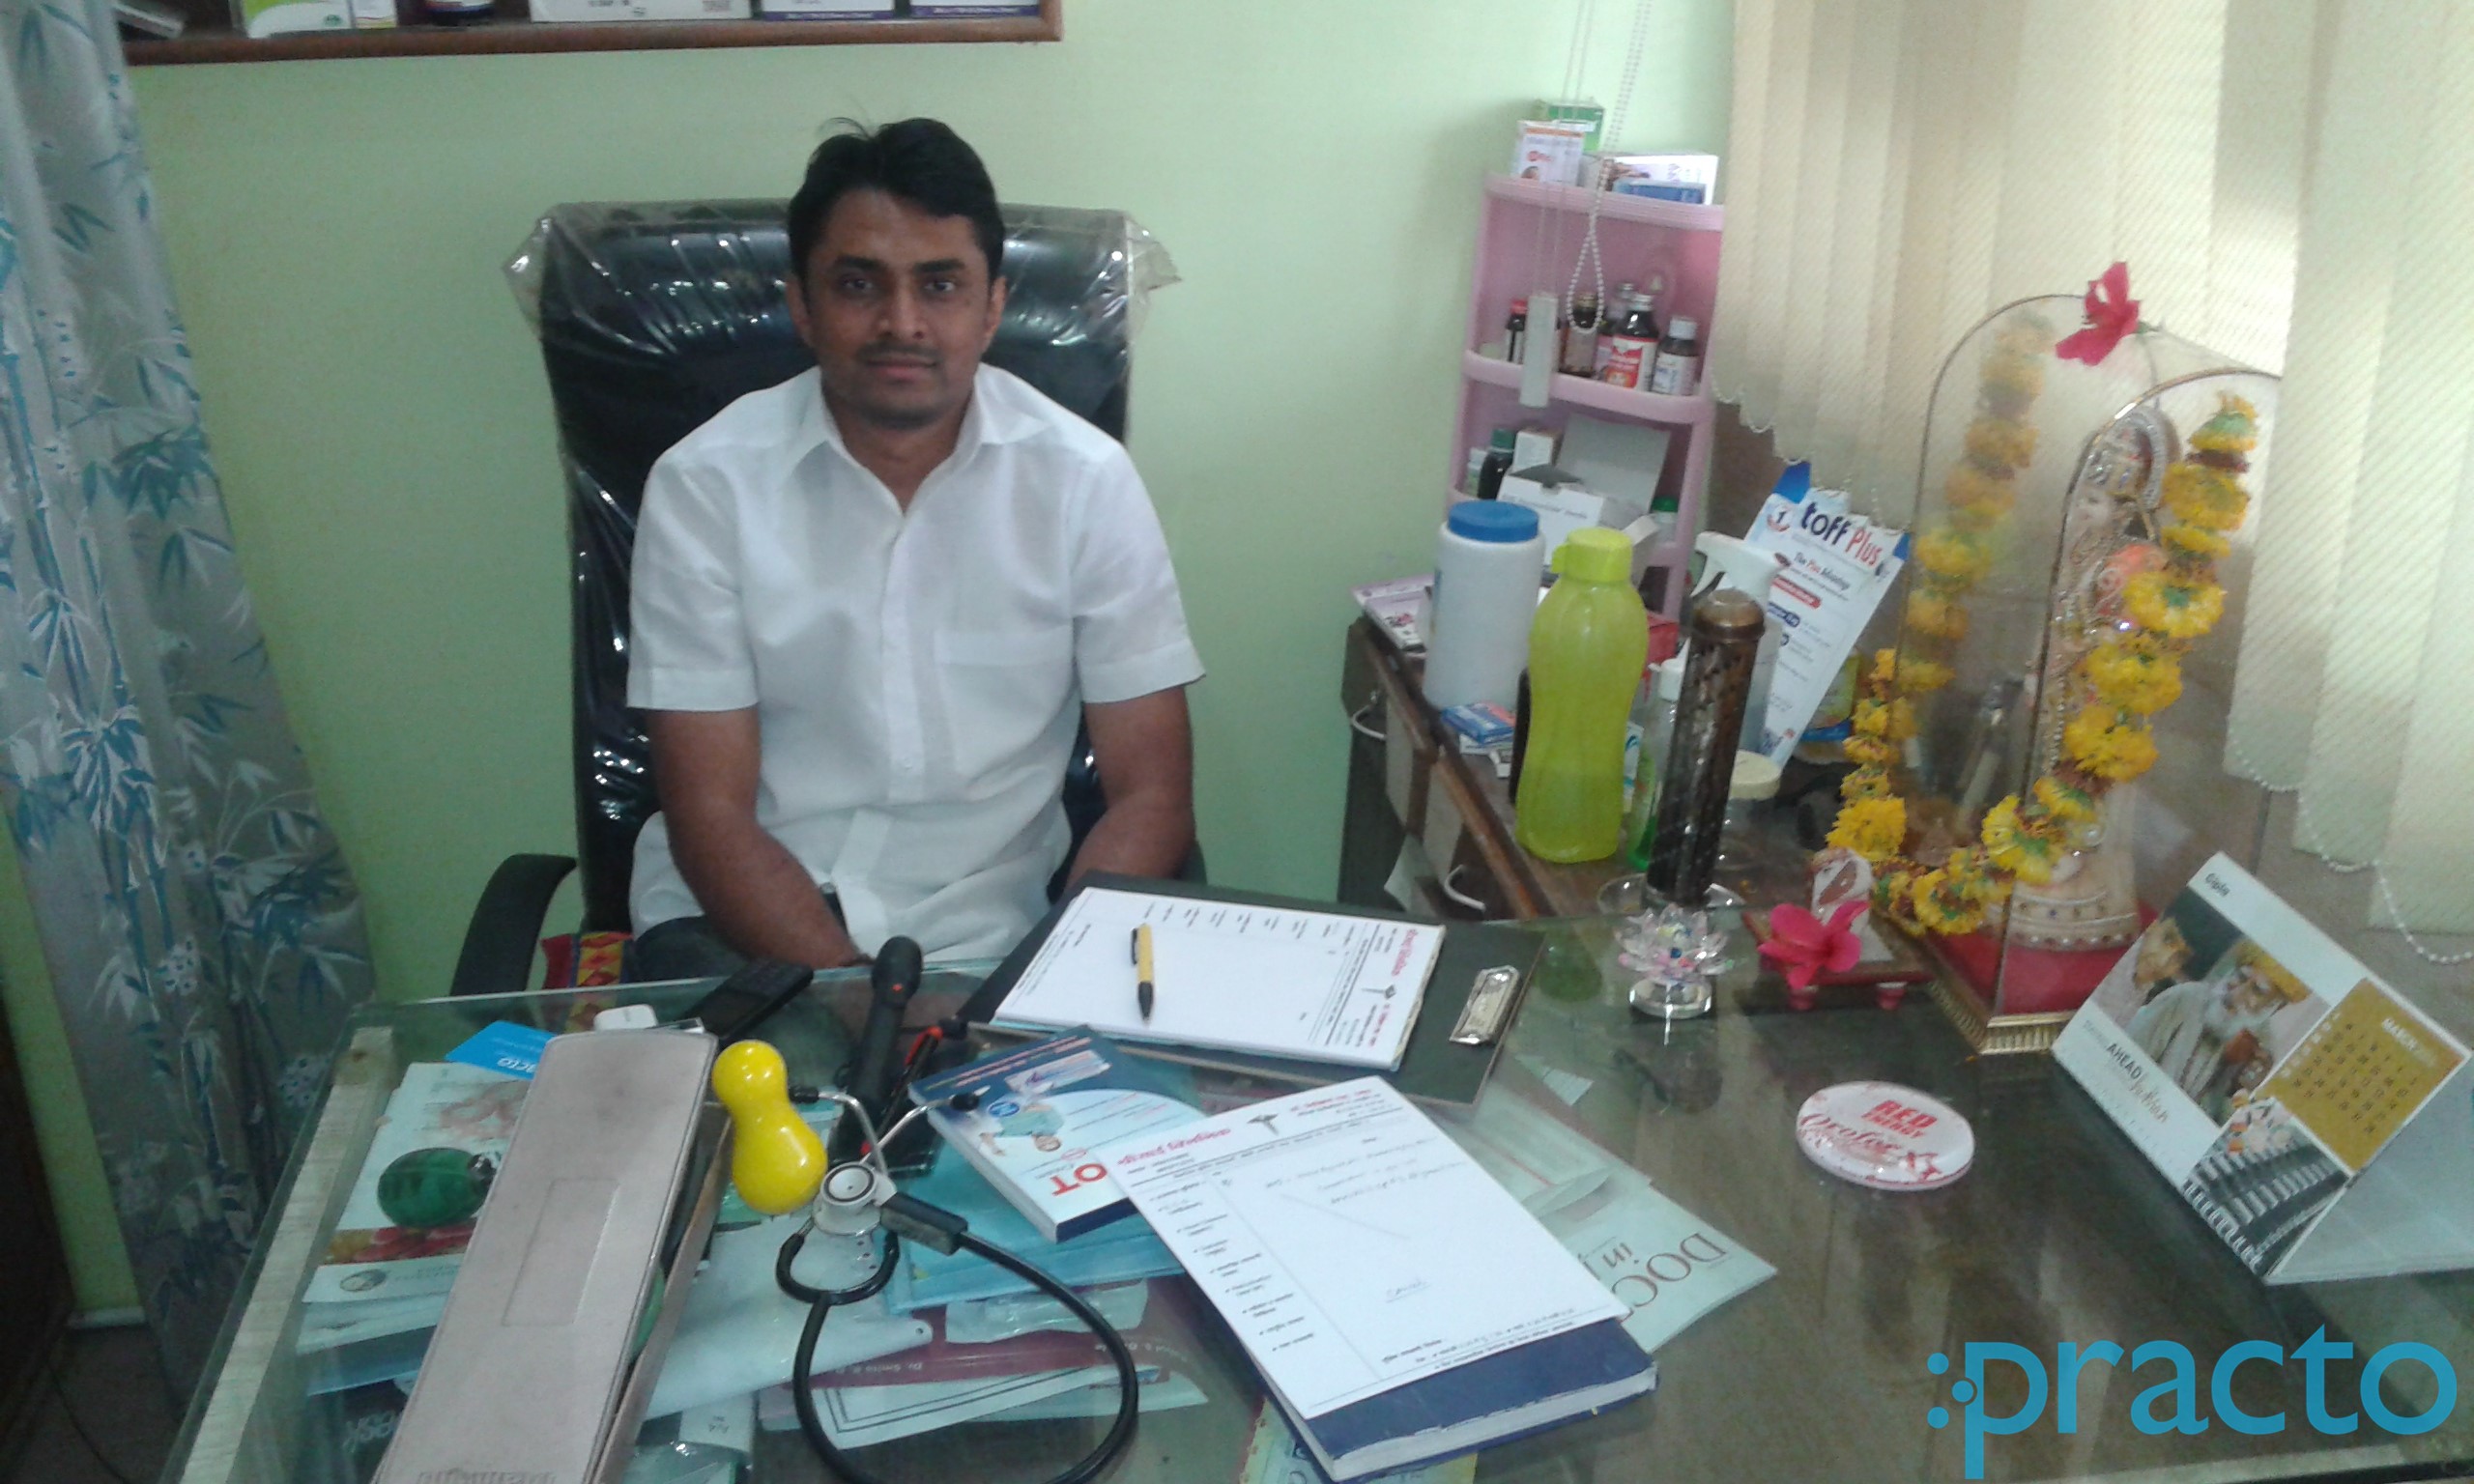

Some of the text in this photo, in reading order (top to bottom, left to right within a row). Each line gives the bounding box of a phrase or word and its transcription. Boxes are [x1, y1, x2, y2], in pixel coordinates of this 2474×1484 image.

[1800, 501, 1852, 545] toff
[1844, 527, 1884, 566] Plus
[2106, 1043, 2143, 1080] AHEAD
[1871, 1099, 1938, 1129] RED
[1611, 1233, 1727, 1323] DOC
